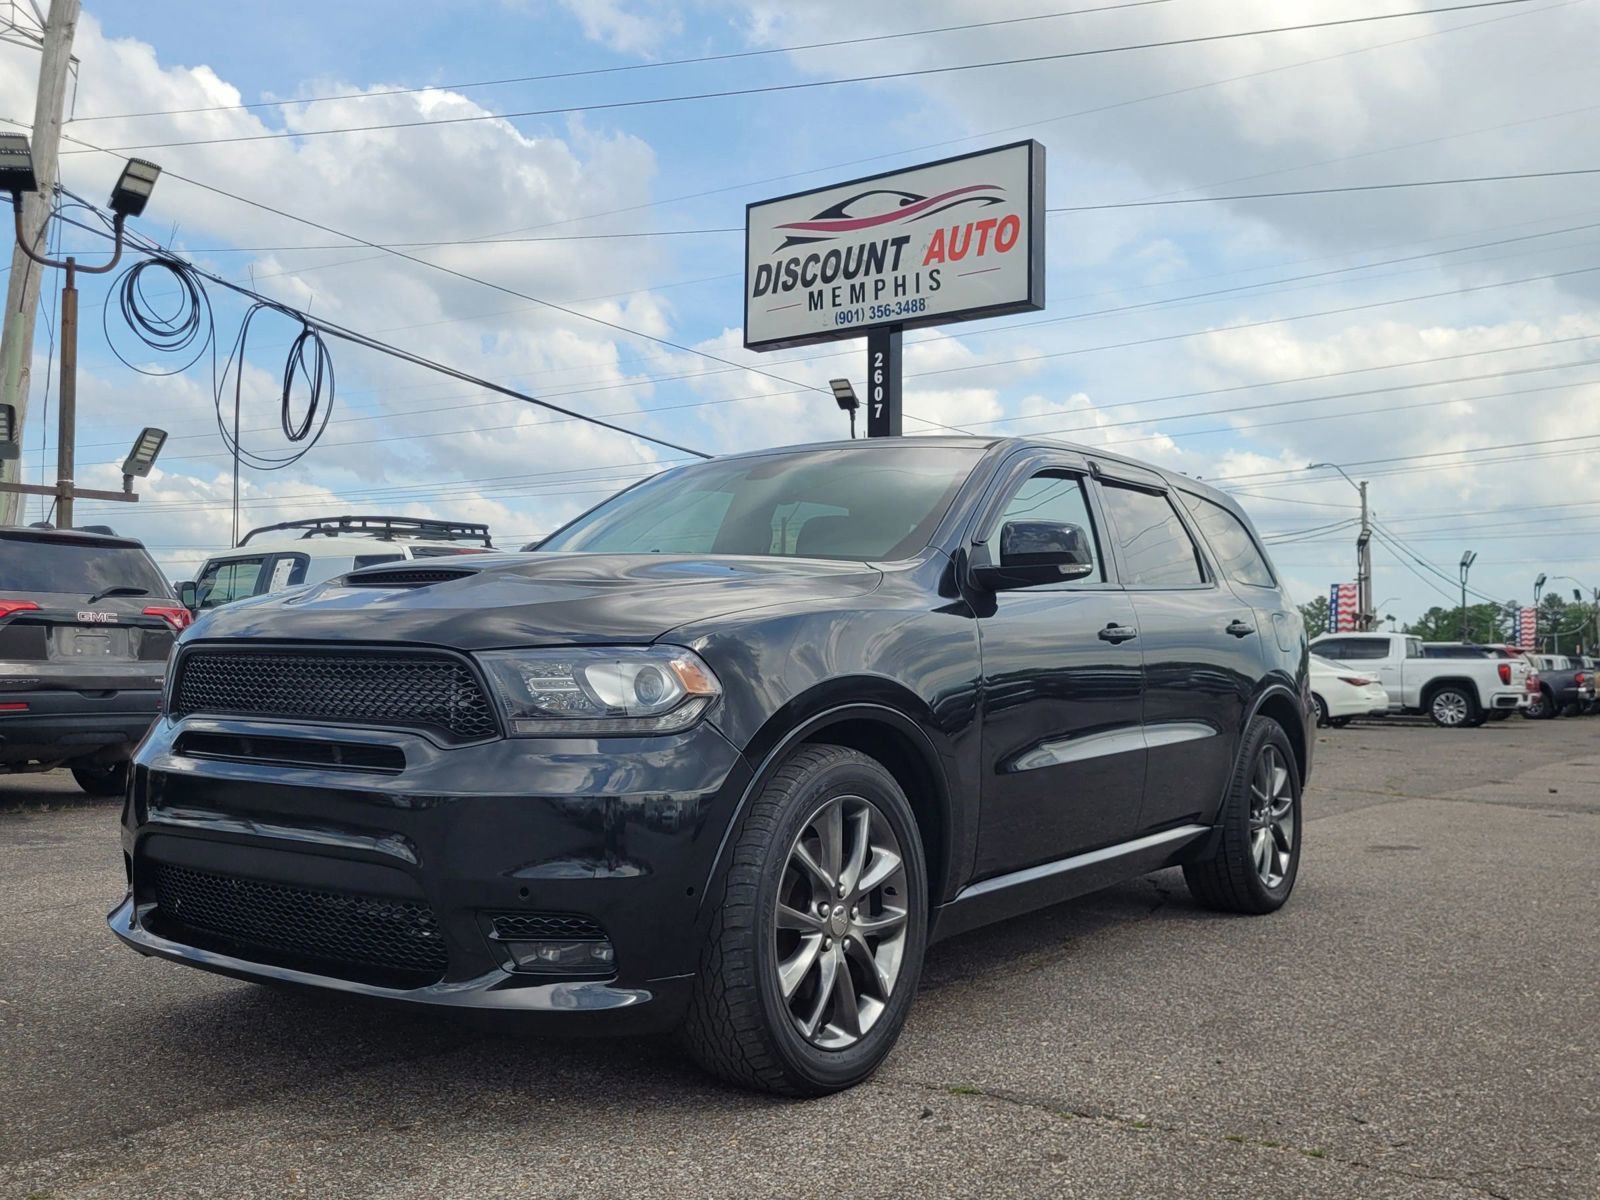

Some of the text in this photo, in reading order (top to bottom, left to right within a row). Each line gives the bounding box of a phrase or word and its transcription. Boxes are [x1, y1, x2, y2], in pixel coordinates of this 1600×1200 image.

[753, 214, 1020, 298] DISCOUNT AUTO
[808, 268, 941, 312] MEMPHIS
[835, 298, 926, 325] (901) 356-3488
[874, 352, 883, 418] 2607
[77, 611, 118, 623] GMC
